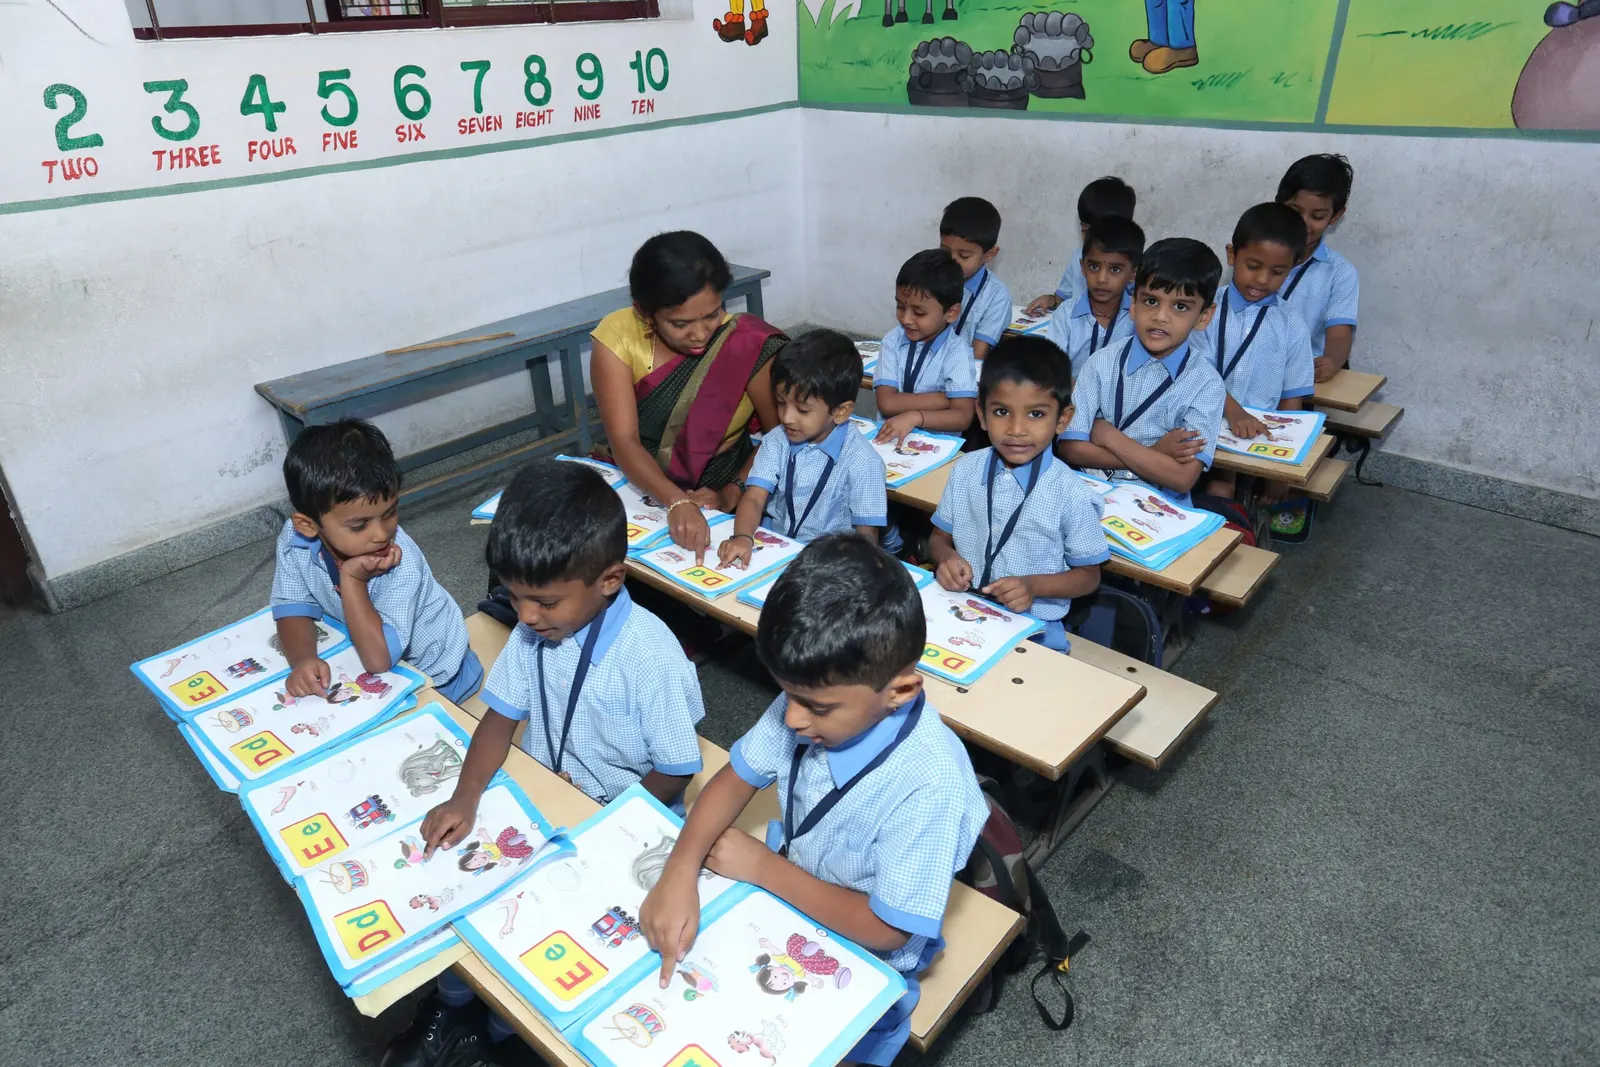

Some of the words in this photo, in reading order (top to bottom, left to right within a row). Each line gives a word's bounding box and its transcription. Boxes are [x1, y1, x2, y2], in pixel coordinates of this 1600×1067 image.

[460, 60, 491, 115] 7
[523, 54, 552, 107] 8
[575, 52, 604, 101] 9
[629, 47, 670, 94] 10
[143, 79, 201, 142] 3
[240, 74, 287, 133] 4
[317, 68, 359, 127] 5
[393, 64, 432, 122] 6
[632, 99, 655, 115] TEN
[43, 83, 104, 152] 2
[457, 115, 503, 135] SEVEN
[515, 109, 554, 129] EIGHT
[574, 104, 600, 122] NINE
[248, 137, 297, 162] FOUR
[322, 129, 358, 152] FIVE
[395, 123, 426, 143] SIX
[42, 157, 99, 184] TWO
[152, 144, 222, 171] THREE
